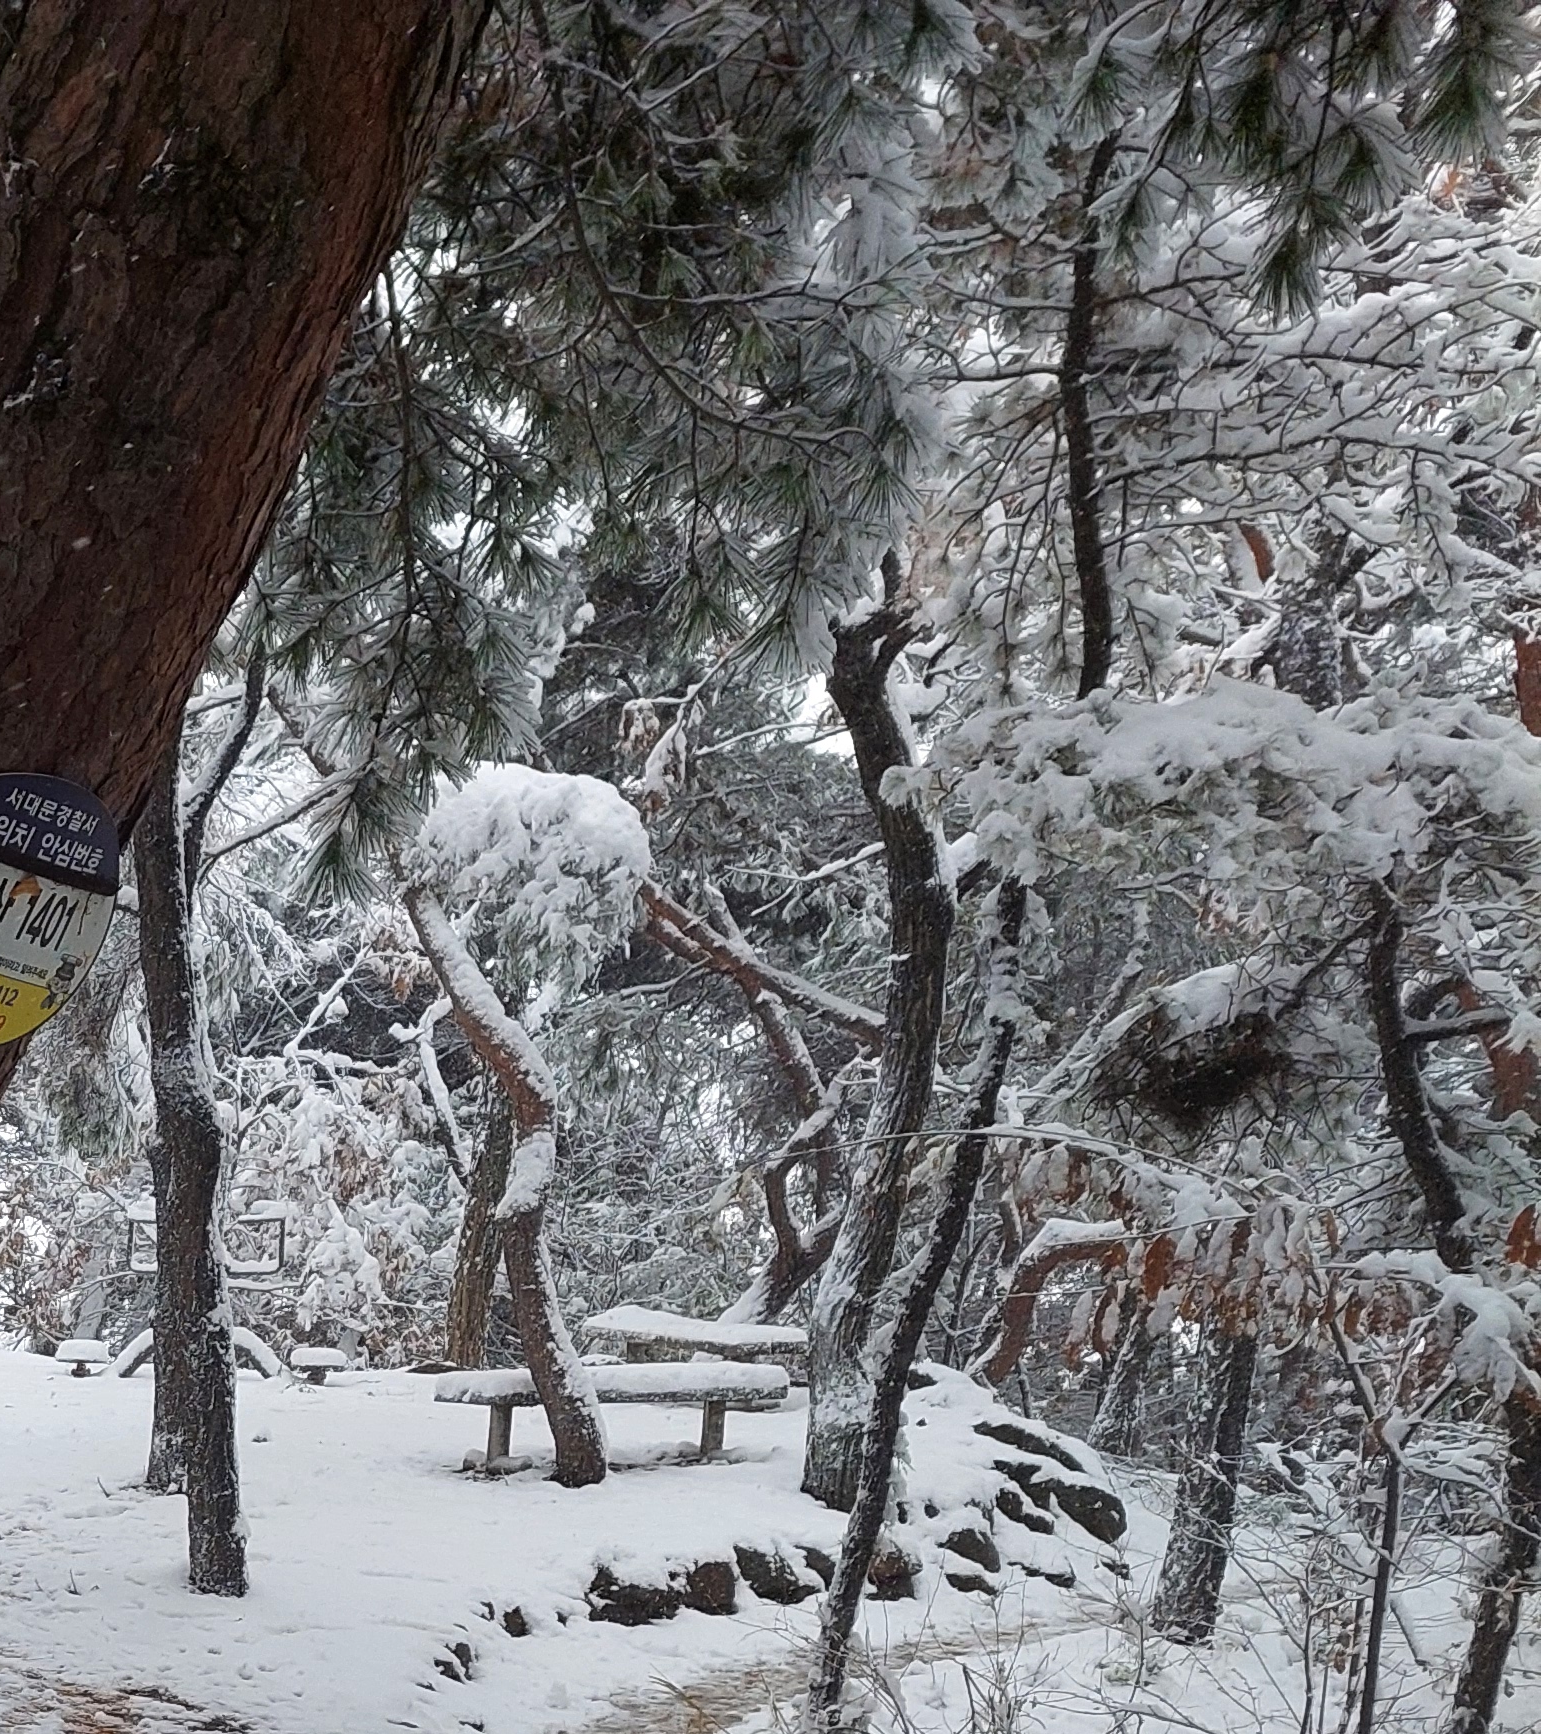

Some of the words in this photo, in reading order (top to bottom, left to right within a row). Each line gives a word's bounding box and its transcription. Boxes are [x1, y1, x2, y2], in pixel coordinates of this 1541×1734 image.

[5, 787, 100, 837] 서대문경찰서
[36, 833, 104, 875] 안심번호
[15, 888, 80, 951] 1401
